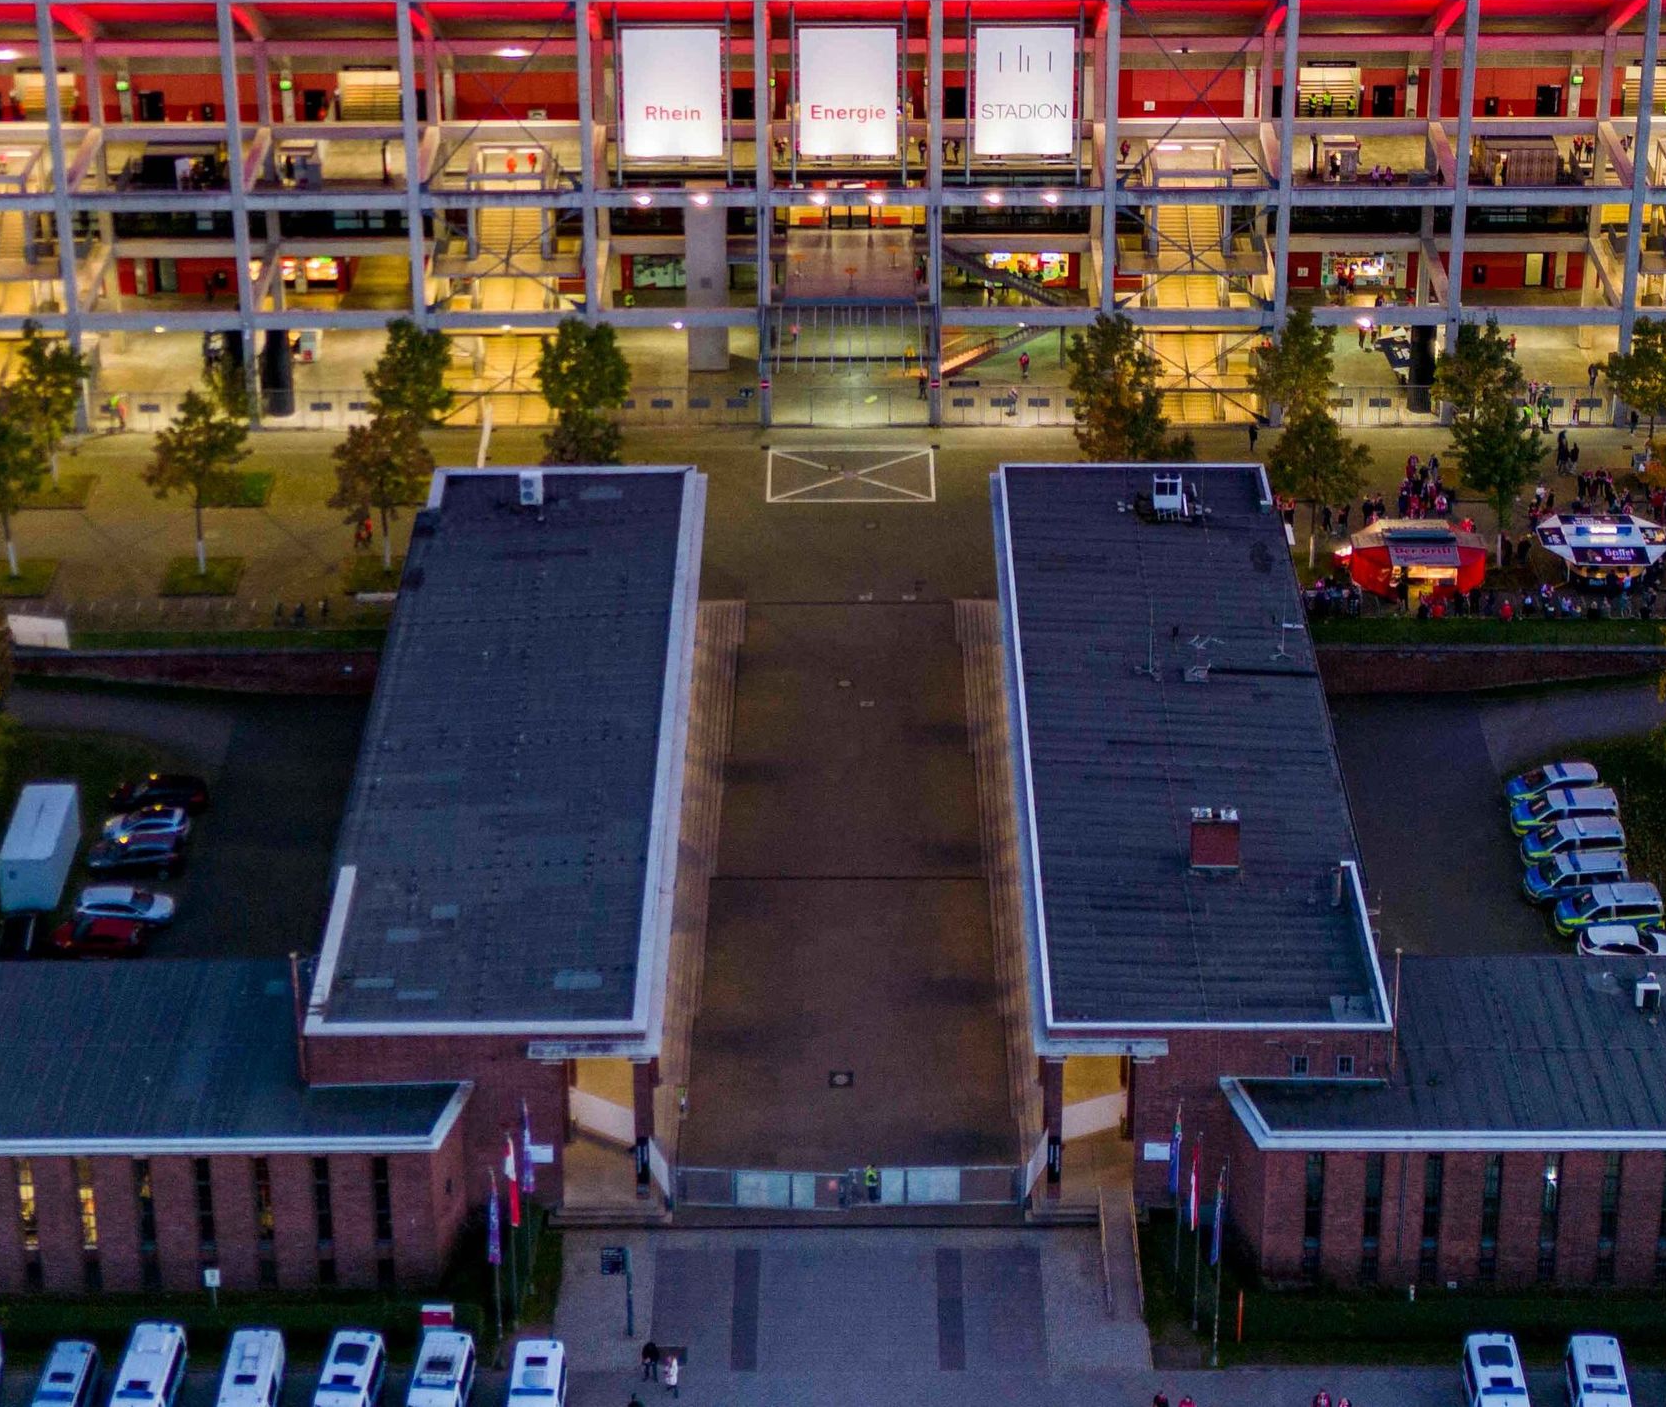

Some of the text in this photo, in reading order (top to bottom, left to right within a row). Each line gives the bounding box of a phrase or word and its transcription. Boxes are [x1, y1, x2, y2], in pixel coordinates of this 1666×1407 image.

[644, 105, 701, 121] Rhein
[810, 104, 886, 124] Energie
[981, 103, 1068, 120] STADION
